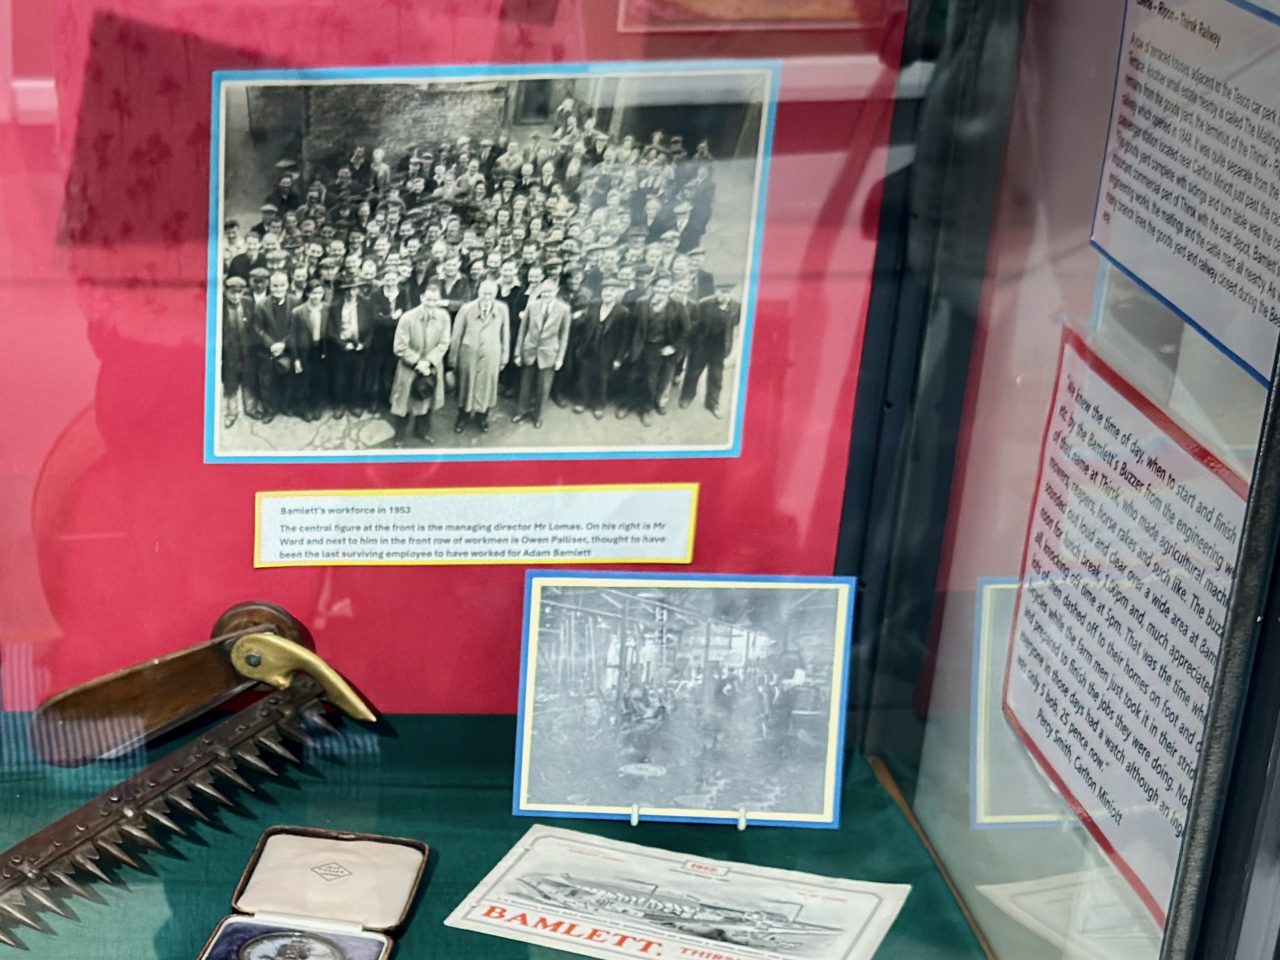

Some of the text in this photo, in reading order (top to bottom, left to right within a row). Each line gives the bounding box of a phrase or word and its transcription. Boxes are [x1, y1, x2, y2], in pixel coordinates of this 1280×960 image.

[280, 506, 411, 515] Bamlett's workforce in 1953
[280, 524, 297, 533] The
[299, 524, 332, 533] central
[334, 523, 365, 534] figure
[365, 524, 374, 532] at
[375, 523, 390, 532] the
[392, 523, 417, 532] front
[418, 523, 426, 532] is
[428, 523, 443, 532] the
[445, 522, 492, 533] managing
[493, 522, 532, 531] director
[534, 522, 547, 531] Mr
[586, 522, 599, 531] On
[601, 521, 616, 531] his
[618, 521, 641, 532] right
[642, 522, 651, 530] is
[653, 522, 666, 530] Mr
[280, 537, 304, 546] Ward
[306, 536, 324, 546] and
[326, 536, 346, 546] next
[348, 537, 358, 546] to
[359, 536, 378, 546] him
[380, 536, 389, 545] in
[390, 536, 406, 545] the
[408, 536, 431, 545] front
[452, 536, 462, 544] of
[464, 536, 509, 544] workmen
[510, 536, 519, 544] is
[521, 536, 548, 544] Owen
[591, 534, 628, 546] thought
[630, 535, 640, 544] to
[642, 534, 666, 544] have
[279, 548, 592, 560] been the last surviving employee to have worked for Adam Bamlett
